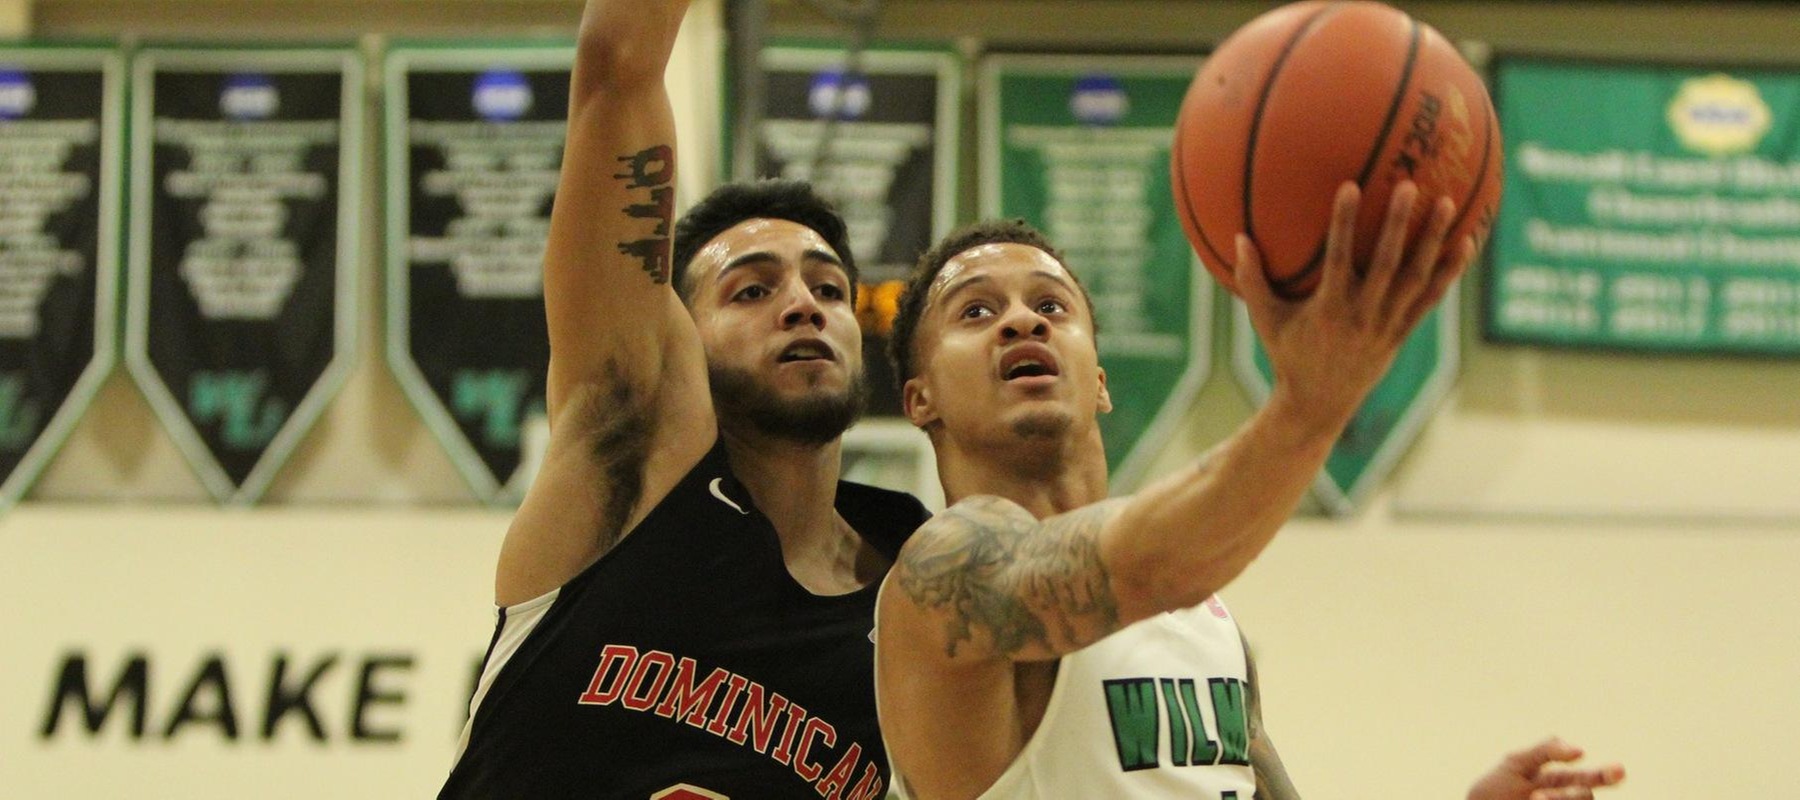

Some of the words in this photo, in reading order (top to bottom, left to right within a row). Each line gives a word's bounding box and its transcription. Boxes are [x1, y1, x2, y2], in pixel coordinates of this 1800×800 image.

[40, 651, 414, 742] MAKE
[578, 645, 882, 800] DOMINICAN
[1102, 677, 1249, 771] WILM
